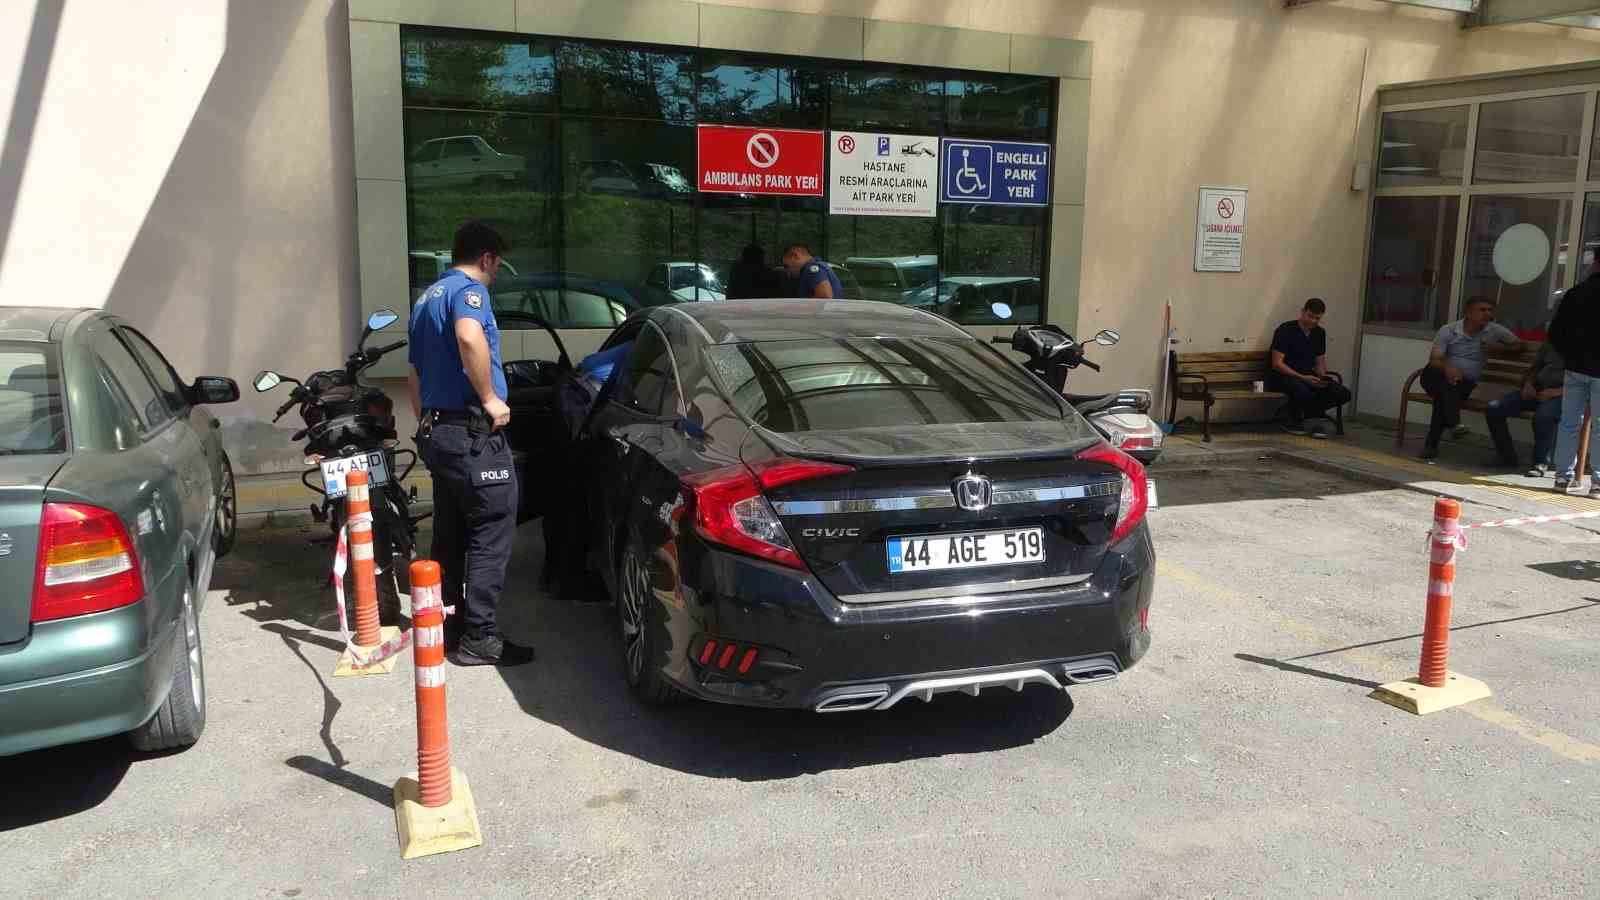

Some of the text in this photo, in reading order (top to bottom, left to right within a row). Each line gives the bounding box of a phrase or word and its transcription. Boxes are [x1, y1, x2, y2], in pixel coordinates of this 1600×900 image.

[996, 151, 1047, 165] ENGELLİ
[863, 162, 906, 172] HASTANE
[704, 171, 819, 189] AMBULANS PARK YERİ
[839, 174, 868, 186] RESMİ
[1004, 168, 1037, 181] PARK
[852, 189, 917, 203] AİT PARK YERİ
[1007, 184, 1035, 198] YERİ
[327, 454, 381, 476] 44 AHD
[802, 528, 860, 537] CIVIC
[904, 531, 1041, 566] 44 AGE 519
